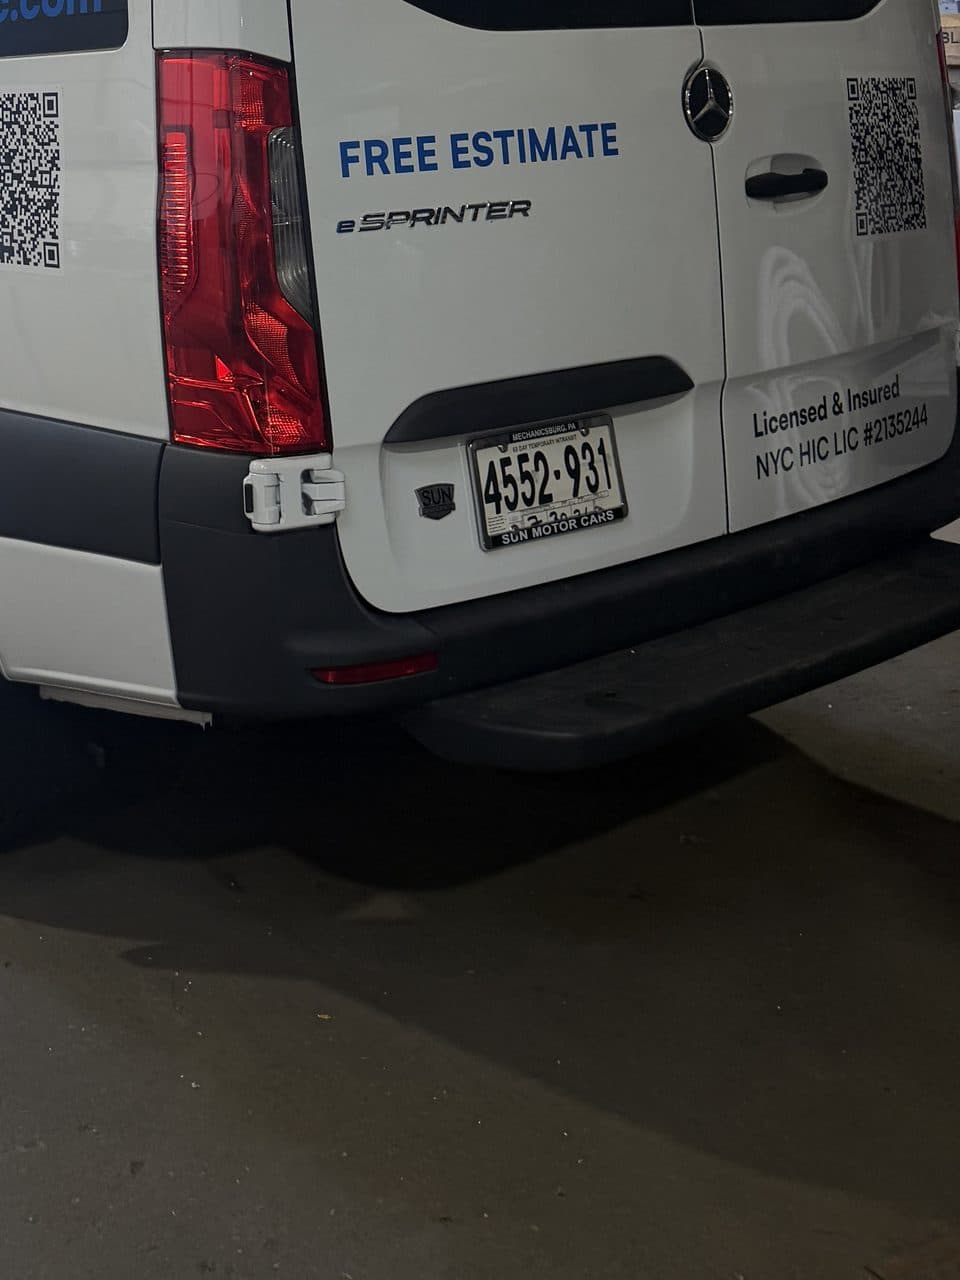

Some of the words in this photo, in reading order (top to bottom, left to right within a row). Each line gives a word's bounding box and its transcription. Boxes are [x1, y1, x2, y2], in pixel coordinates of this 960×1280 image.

[339, 135, 438, 178] FREE
[450, 122, 619, 169] ESTIMATE
[568, 422, 577, 430] PA
[753, 396, 828, 438] Licensed
[832, 392, 844, 416] &
[847, 374, 900, 412] Insured
[756, 446, 794, 480] NYC
[799, 436, 829, 466] HIC
[834, 427, 859, 456] LIC
[863, 403, 928, 447] #2135244
[422, 487, 453, 507] SUN
[502, 528, 529, 545] SUN
[532, 517, 578, 538] MOTOR
[580, 510, 614, 527] CARS
